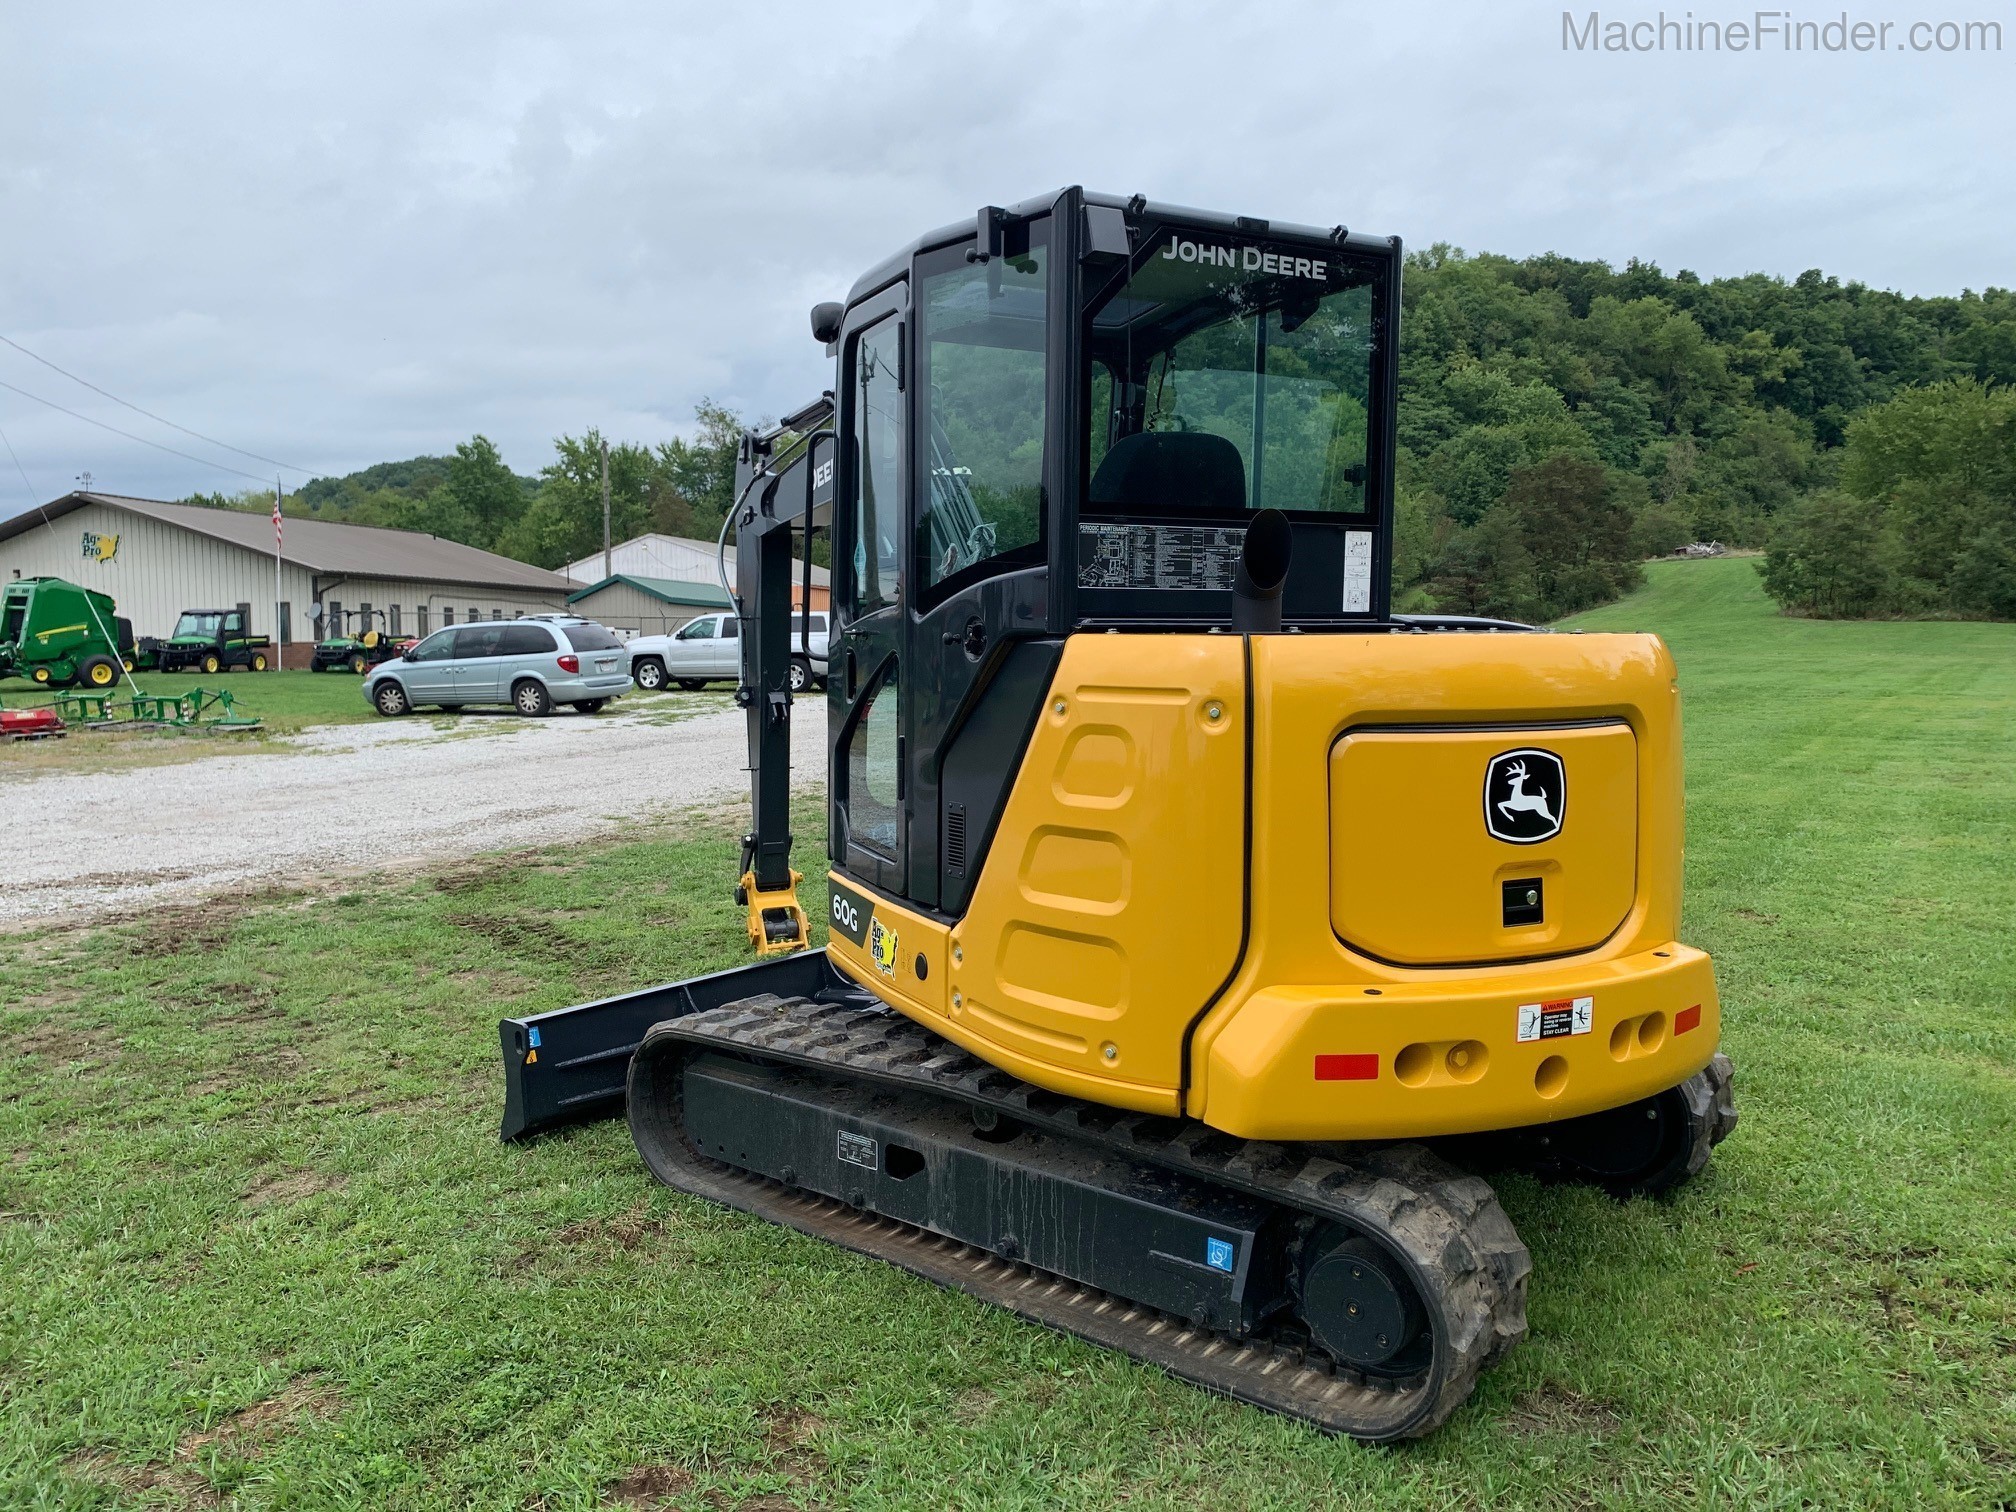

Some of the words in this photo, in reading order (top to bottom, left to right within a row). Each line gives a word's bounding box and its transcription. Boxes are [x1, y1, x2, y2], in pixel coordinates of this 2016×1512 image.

[1162, 235, 1236, 268] JOHN
[1242, 246, 1327, 281] DEERE
[82, 546, 101, 556] Pro
[833, 894, 858, 932] 60G
[1548, 1001, 1573, 1010] WARNING
